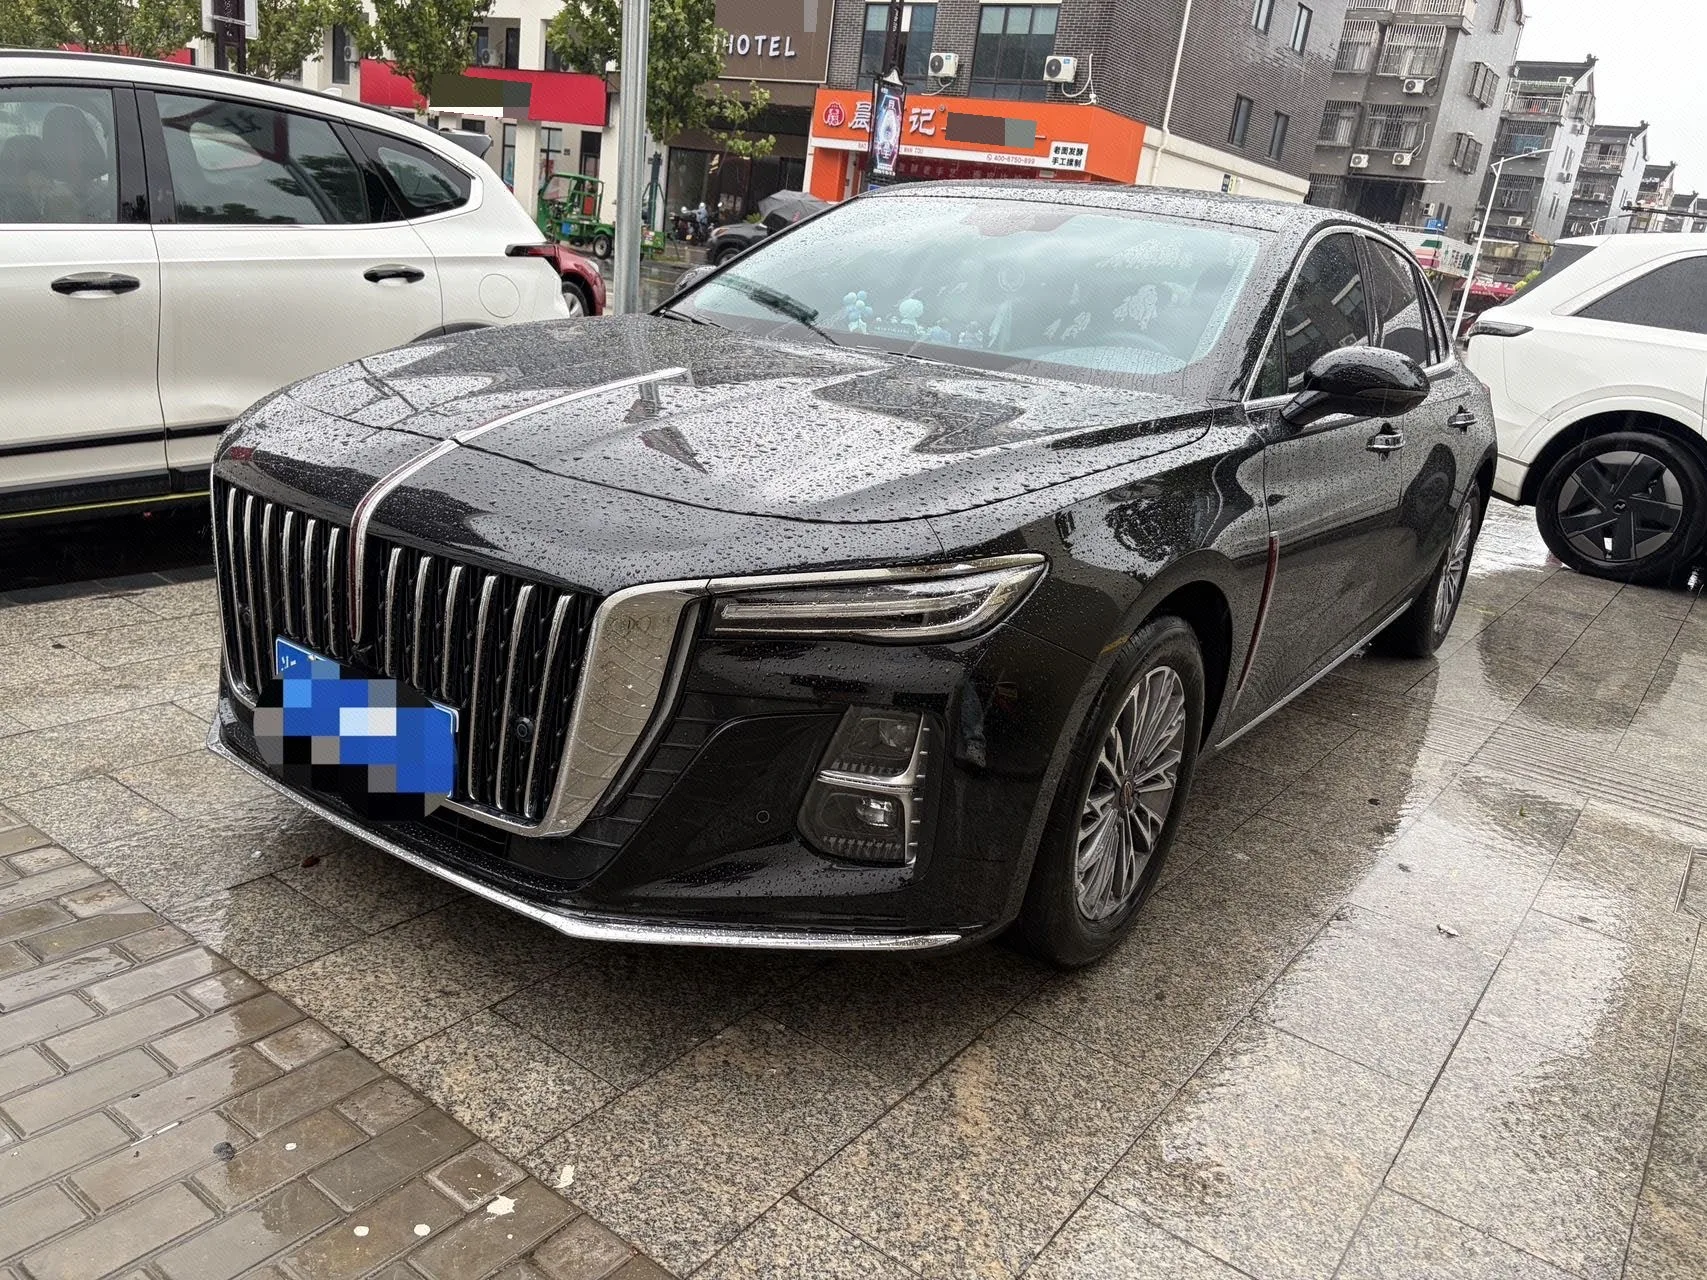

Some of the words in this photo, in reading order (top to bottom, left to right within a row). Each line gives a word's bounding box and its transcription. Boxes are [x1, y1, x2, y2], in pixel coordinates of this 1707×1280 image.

[723, 34, 796, 57] HOTEL
[1054, 145, 1084, 157] 老面发酵
